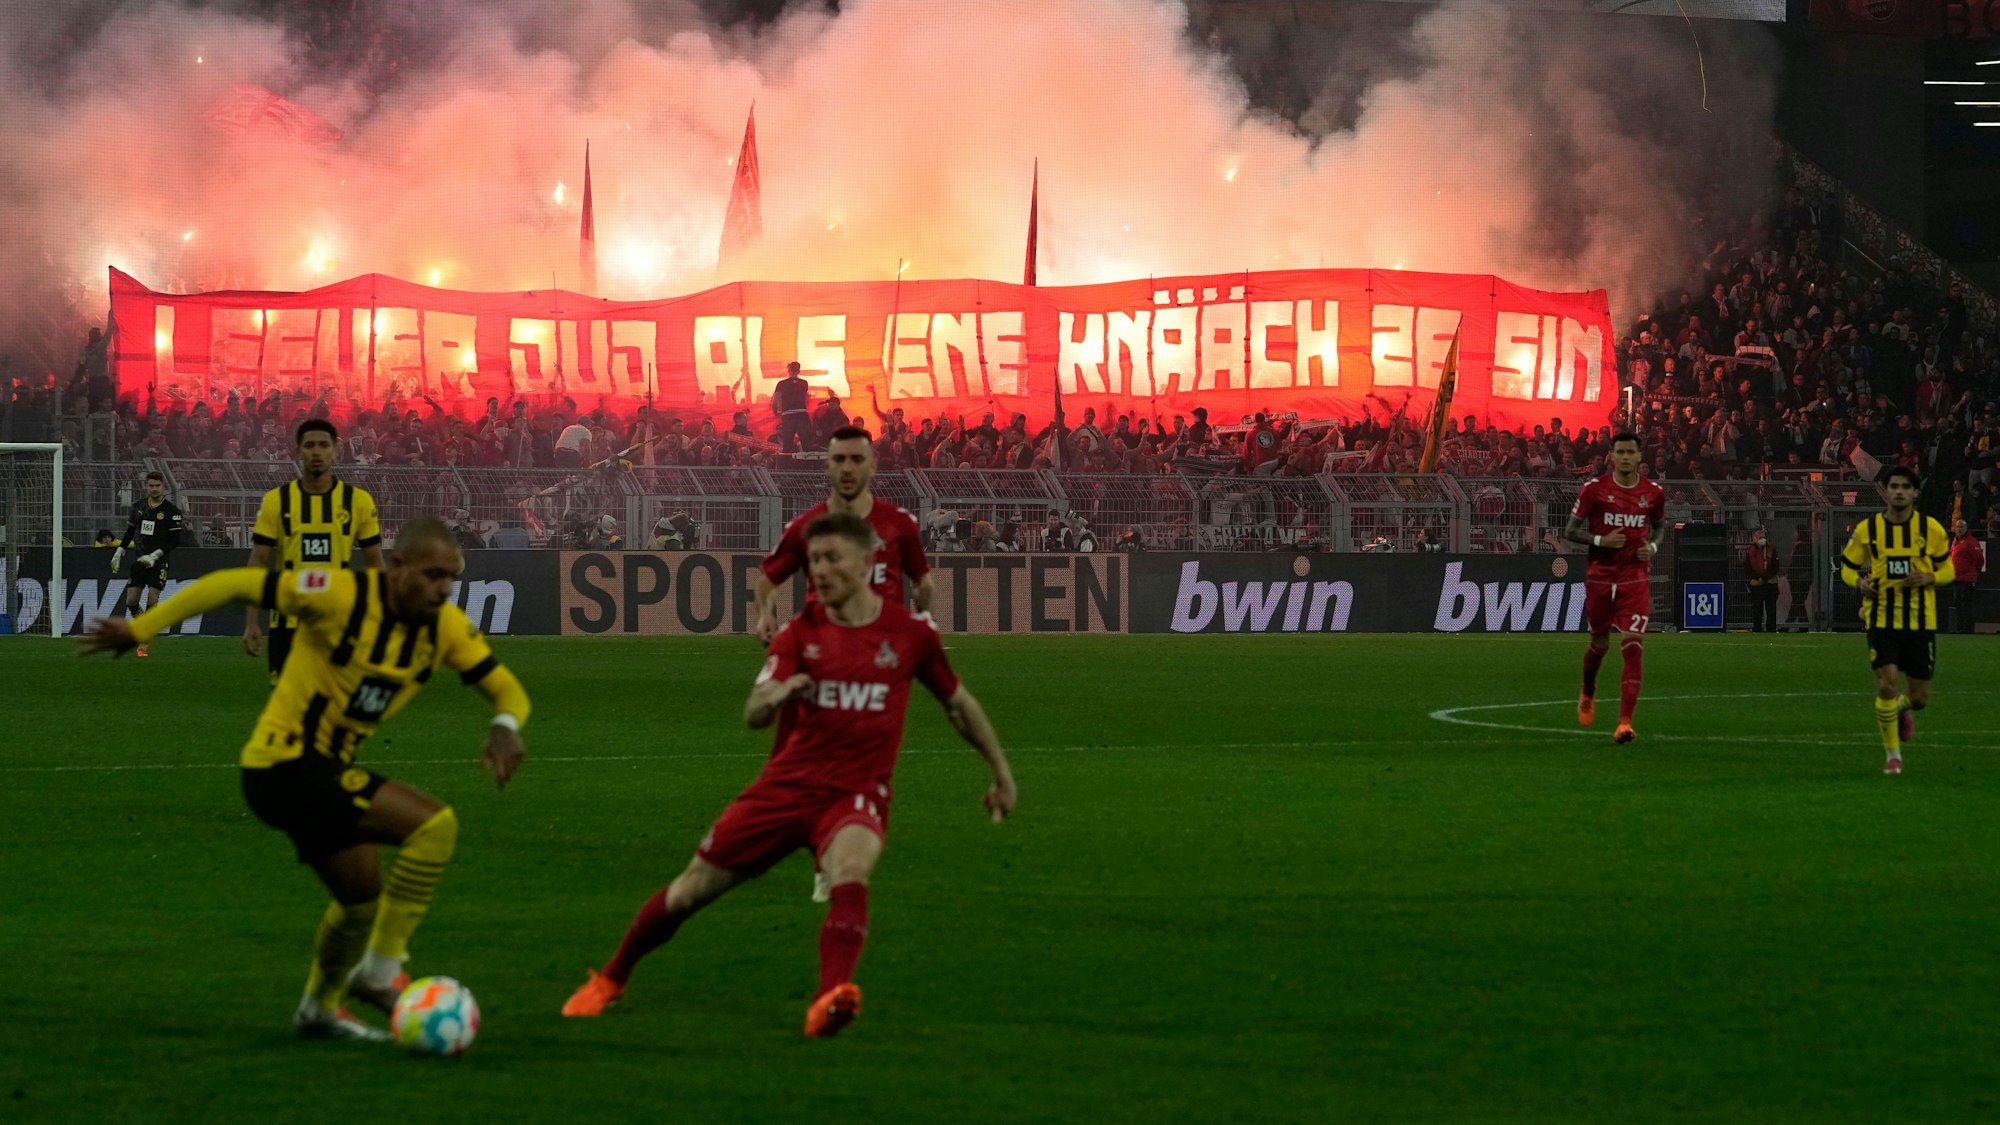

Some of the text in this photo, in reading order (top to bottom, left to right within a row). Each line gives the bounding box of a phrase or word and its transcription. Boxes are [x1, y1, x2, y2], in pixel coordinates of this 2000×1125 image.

[694, 314, 850, 404] ALS
[884, 311, 1029, 399] ENE
[1493, 311, 1603, 402] SIN
[1603, 511, 1647, 528] REWE
[302, 538, 330, 556] 1&1
[1887, 559, 1910, 575] 1&1
[569, 552, 1121, 634] SPORTTEN
[1170, 555, 1355, 633] bwin
[1687, 593, 1720, 617] 1&1
[1629, 613, 1650, 633] 27
